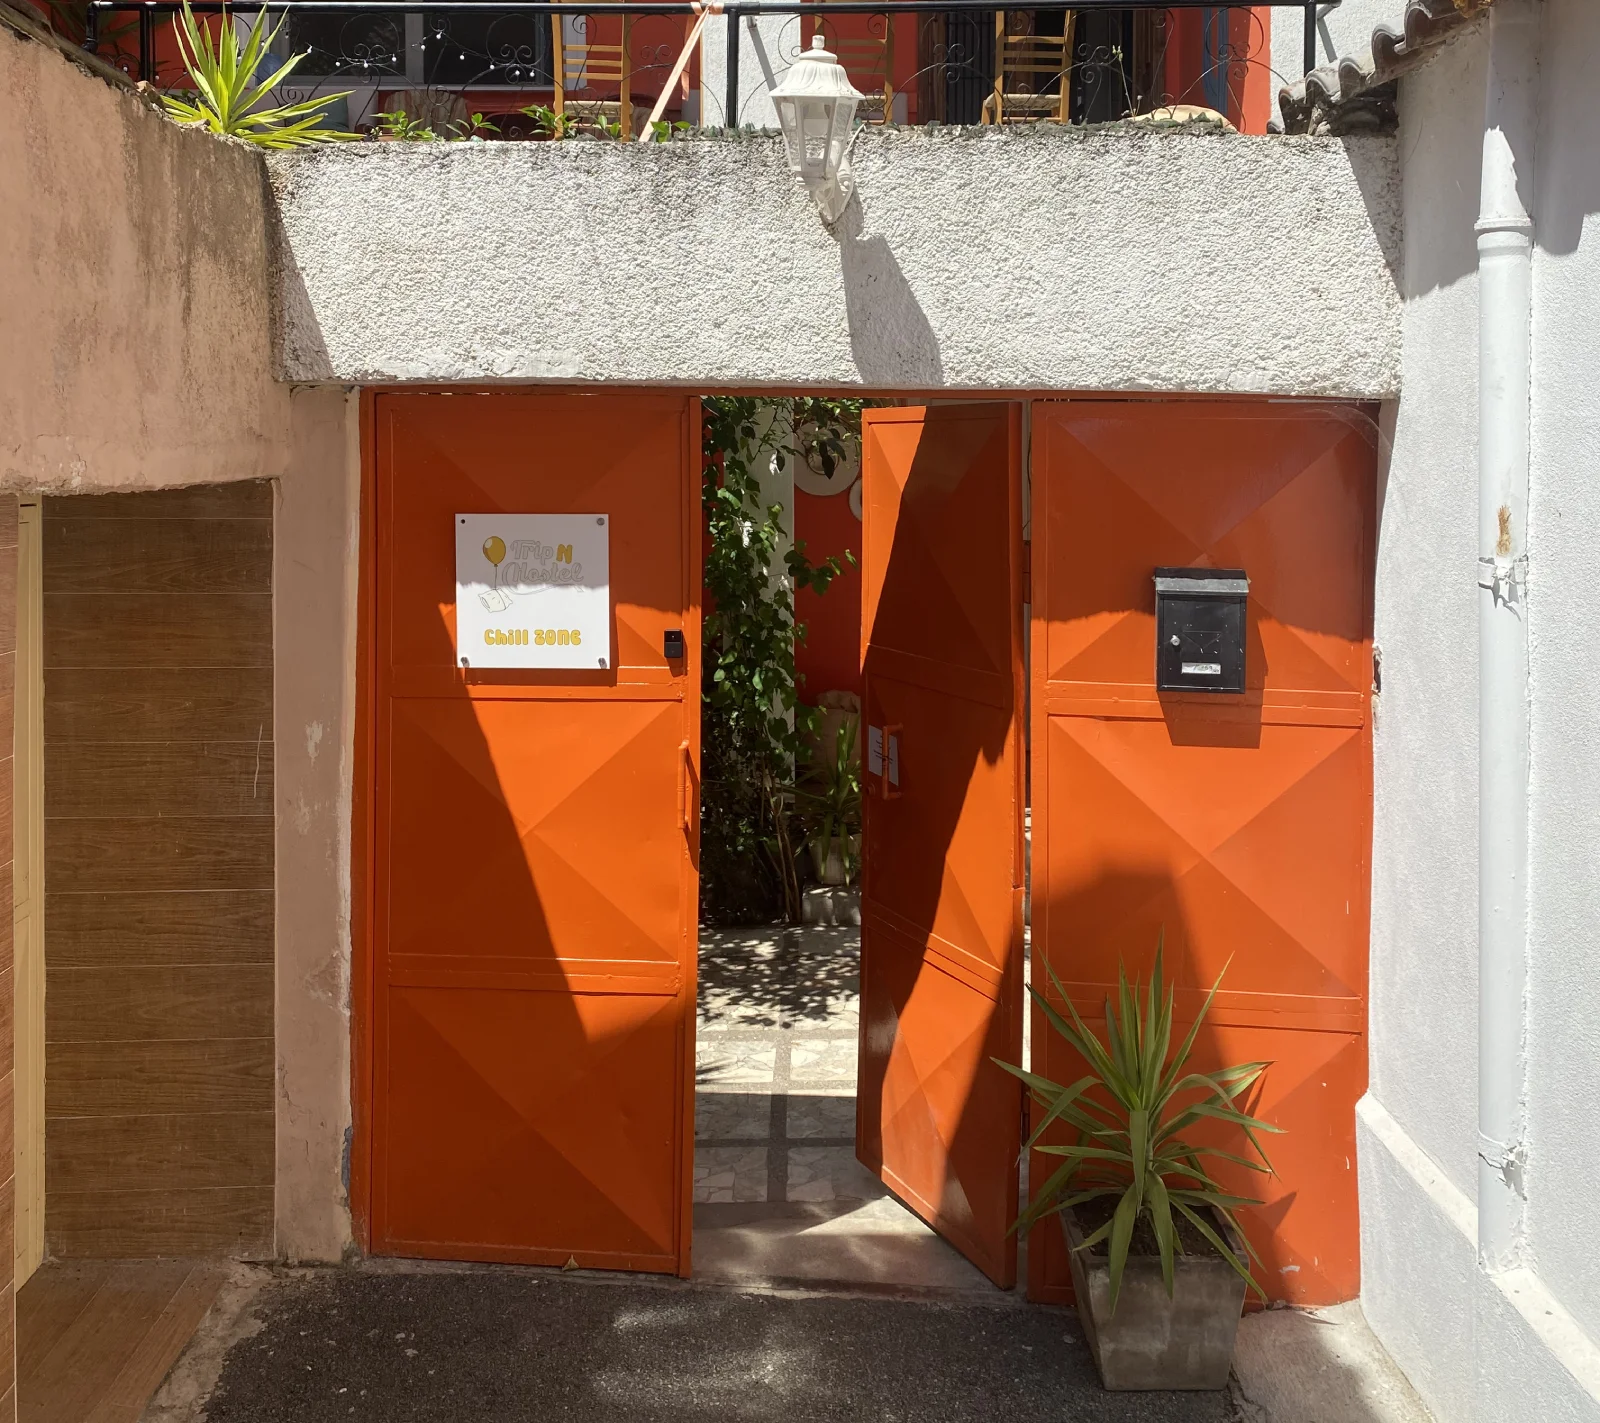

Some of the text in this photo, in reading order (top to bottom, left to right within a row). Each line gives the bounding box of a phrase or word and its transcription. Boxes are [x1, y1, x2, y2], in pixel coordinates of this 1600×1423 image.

[510, 540, 573, 565] Trip N
[502, 562, 584, 586] Hostel
[484, 629, 529, 646] Chill
